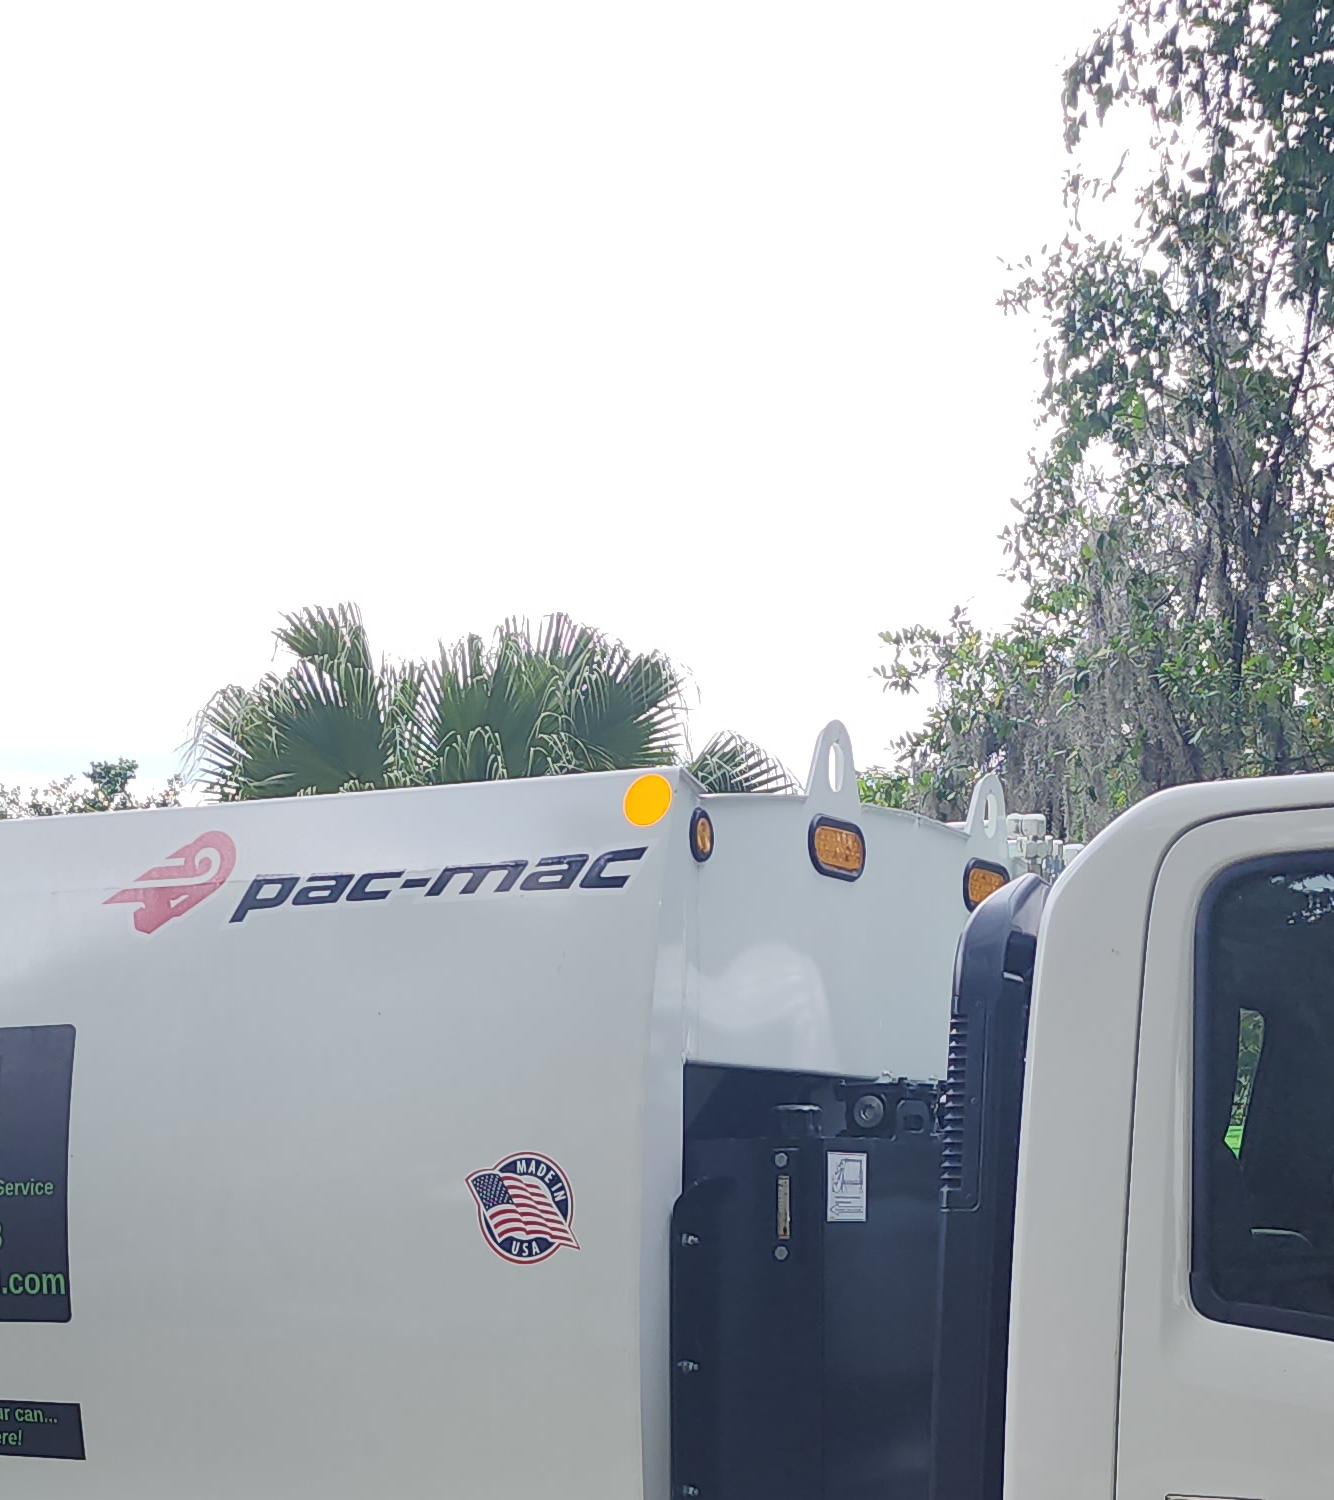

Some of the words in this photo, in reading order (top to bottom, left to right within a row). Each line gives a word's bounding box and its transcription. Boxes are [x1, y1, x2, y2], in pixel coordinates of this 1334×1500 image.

[229, 846, 648, 923] pac-mac
[516, 1159, 555, 1183] MADE
[551, 1182, 566, 1202] IN
[511, 1241, 540, 1257] USA
[15, 1408, 58, 1423] can...
